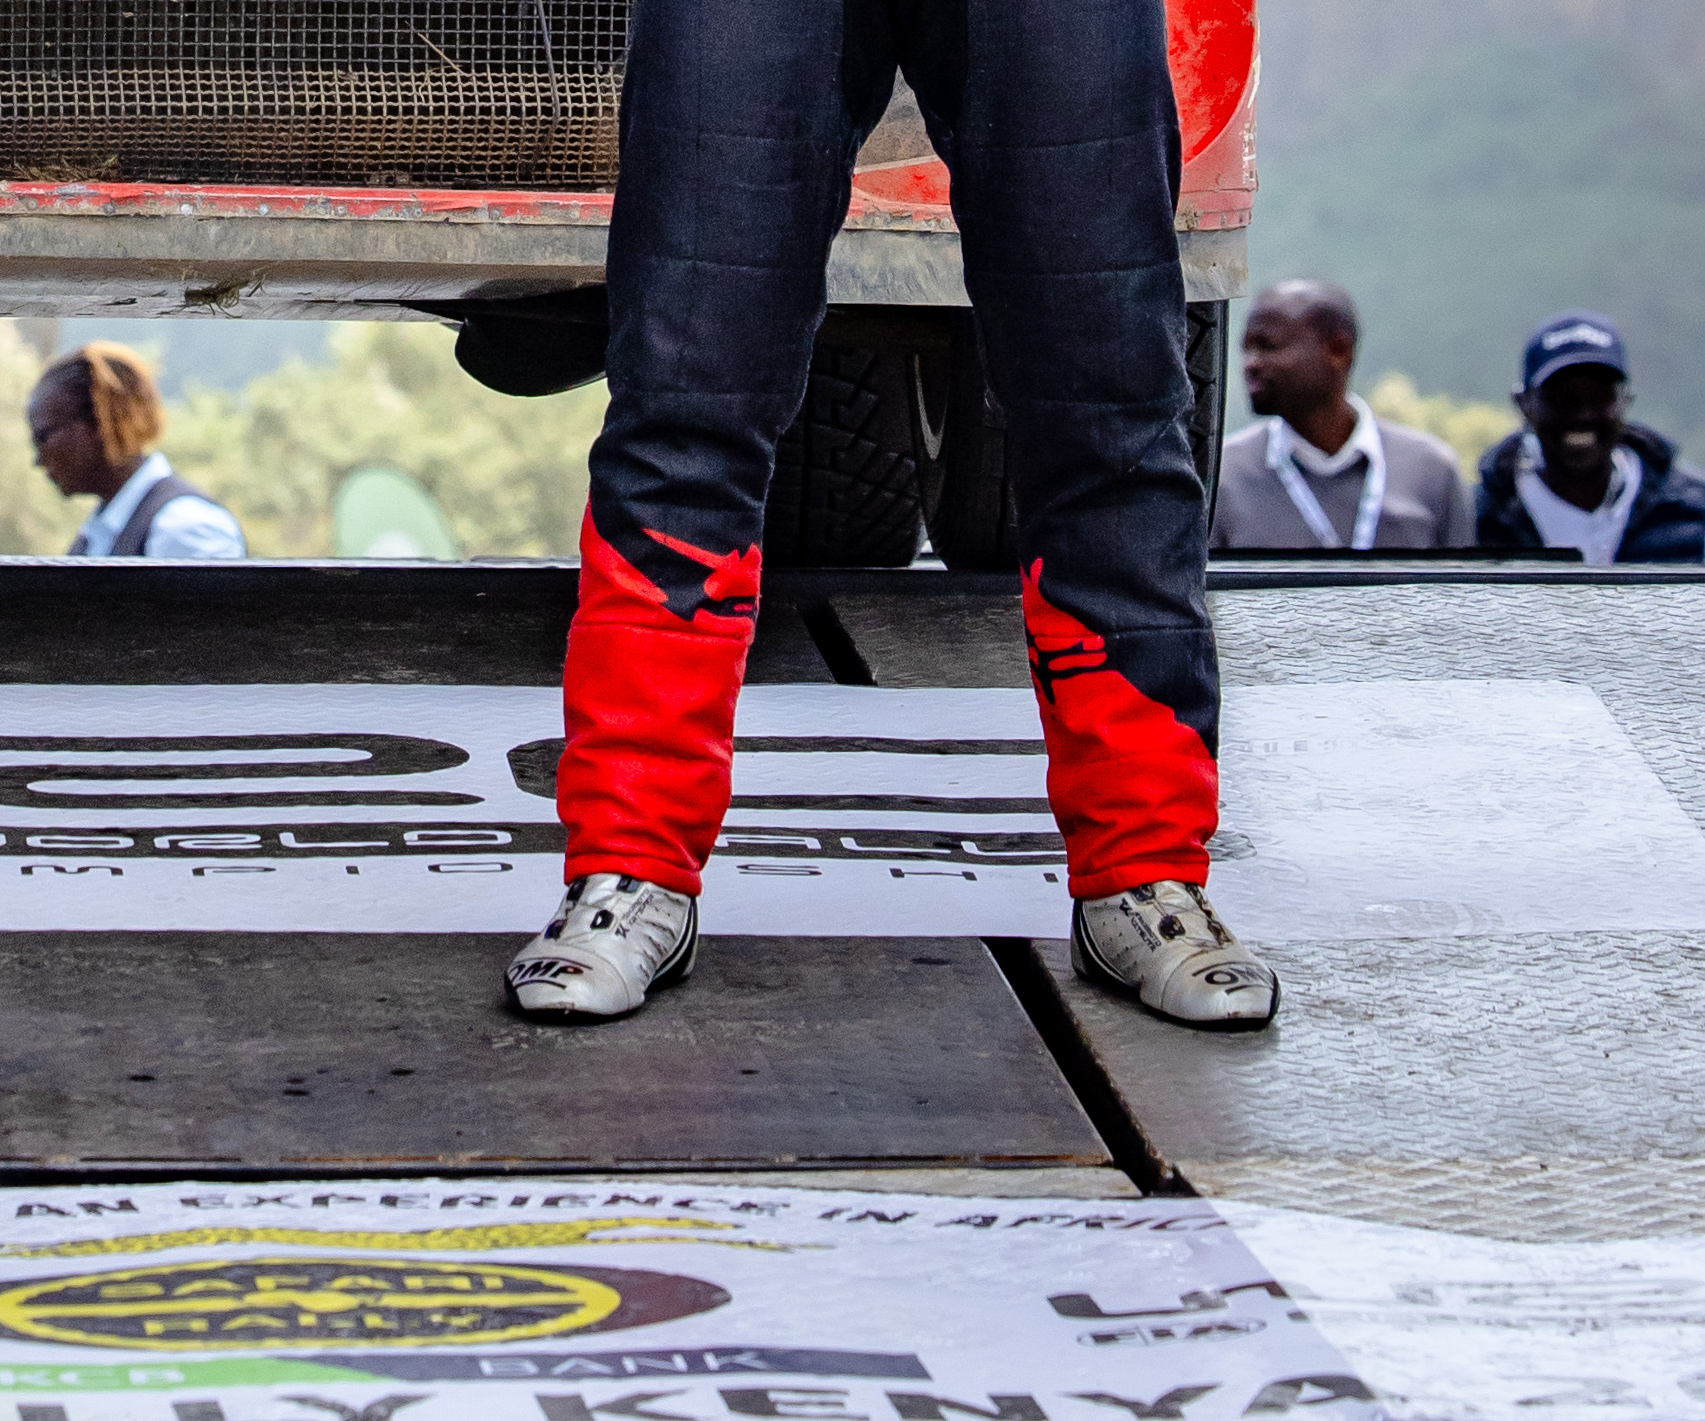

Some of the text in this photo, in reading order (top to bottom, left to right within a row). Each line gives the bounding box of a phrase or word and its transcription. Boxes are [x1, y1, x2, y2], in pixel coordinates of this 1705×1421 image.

[715, 832, 1067, 858] ALL
[180, 1192, 791, 1217] EXPERIENCE
[818, 1206, 918, 1224] IN
[935, 1209, 1231, 1231] AFRIC
[98, 1273, 503, 1298] SAFARI
[478, 1352, 765, 1378] BANK
